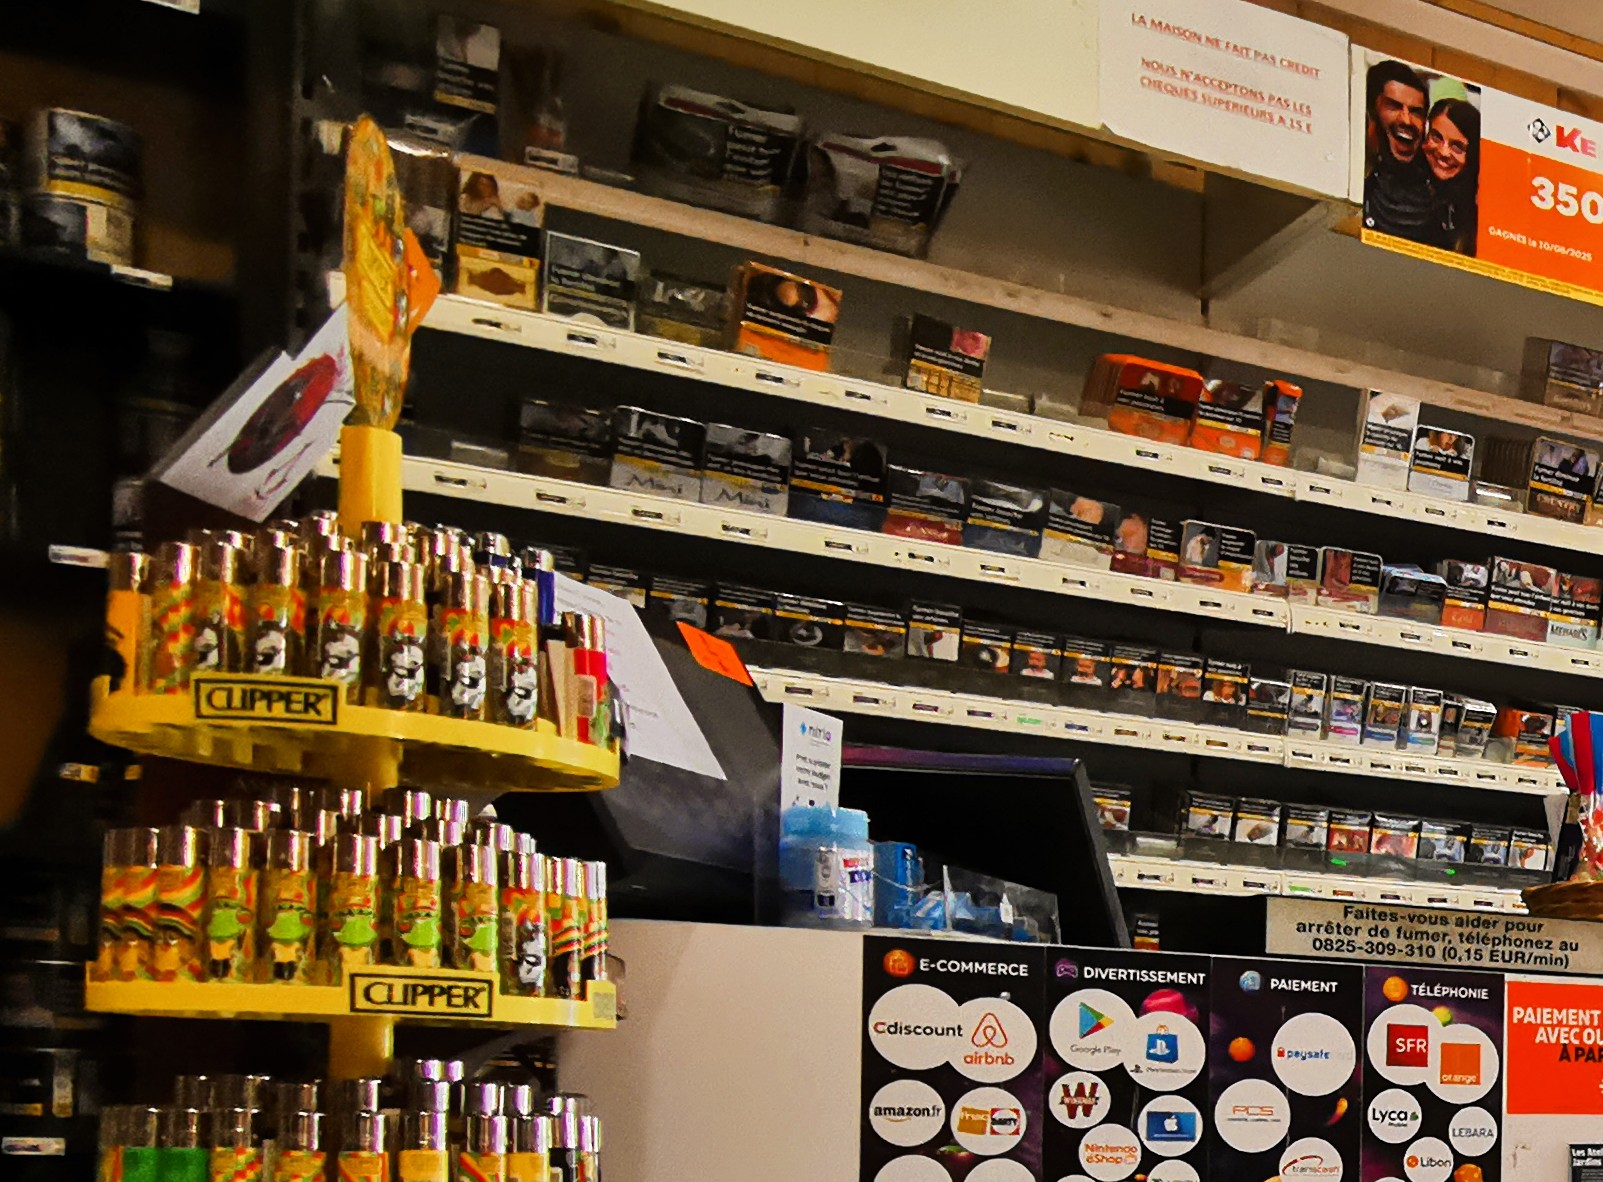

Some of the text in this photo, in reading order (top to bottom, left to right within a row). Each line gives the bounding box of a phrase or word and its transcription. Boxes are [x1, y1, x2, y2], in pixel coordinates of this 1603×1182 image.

[1132, 13, 1147, 27] LA
[1150, 18, 1202, 43] MAISON
[1206, 35, 1221, 49] NE
[1225, 41, 1251, 59] FAIT
[1254, 50, 1276, 66] PAS
[1141, 57, 1177, 78] NOUS
[1268, 94, 1290, 109] PAS
[1293, 101, 1312, 118] LES
[206, 686, 322, 716] CLIPPER
[1343, 905, 1544, 935] Faites-vous aider pour
[1295, 920, 1579, 951] arrêter de fumer, téléphonez au
[1312, 937, 1569, 969] 0825-309-310 (0,15 EUR/min)
[920, 959, 1028, 977] E-COMMERCE
[1084, 967, 1206, 985] DIVERTISSEMENT
[1270, 978, 1338, 992] PAIEMENT
[1411, 982, 1489, 999] TÉLÉPHONIE
[363, 983, 480, 1009] CLIPPER
[1512, 1006, 1601, 1026] PAIEMENT
[873, 1022, 963, 1037] Cdiscount
[1535, 1028, 1579, 1045] AVEC
[1396, 1037, 1427, 1053] SFR
[1559, 1044, 1571, 1063] À
[964, 1052, 1015, 1065] airbnb
[1442, 1073, 1478, 1084] orange
[874, 1104, 942, 1117] amazon.fr
[1232, 1105, 1274, 1116] PCS
[1373, 1107, 1408, 1124] Lyca
[1452, 1128, 1494, 1138] LEBARA
[1085, 1143, 1138, 1154] Nintendo
[1572, 1148, 1585, 1156] Les
[1086, 1154, 1123, 1164] eShop
[1420, 1157, 1451, 1167] Libon
